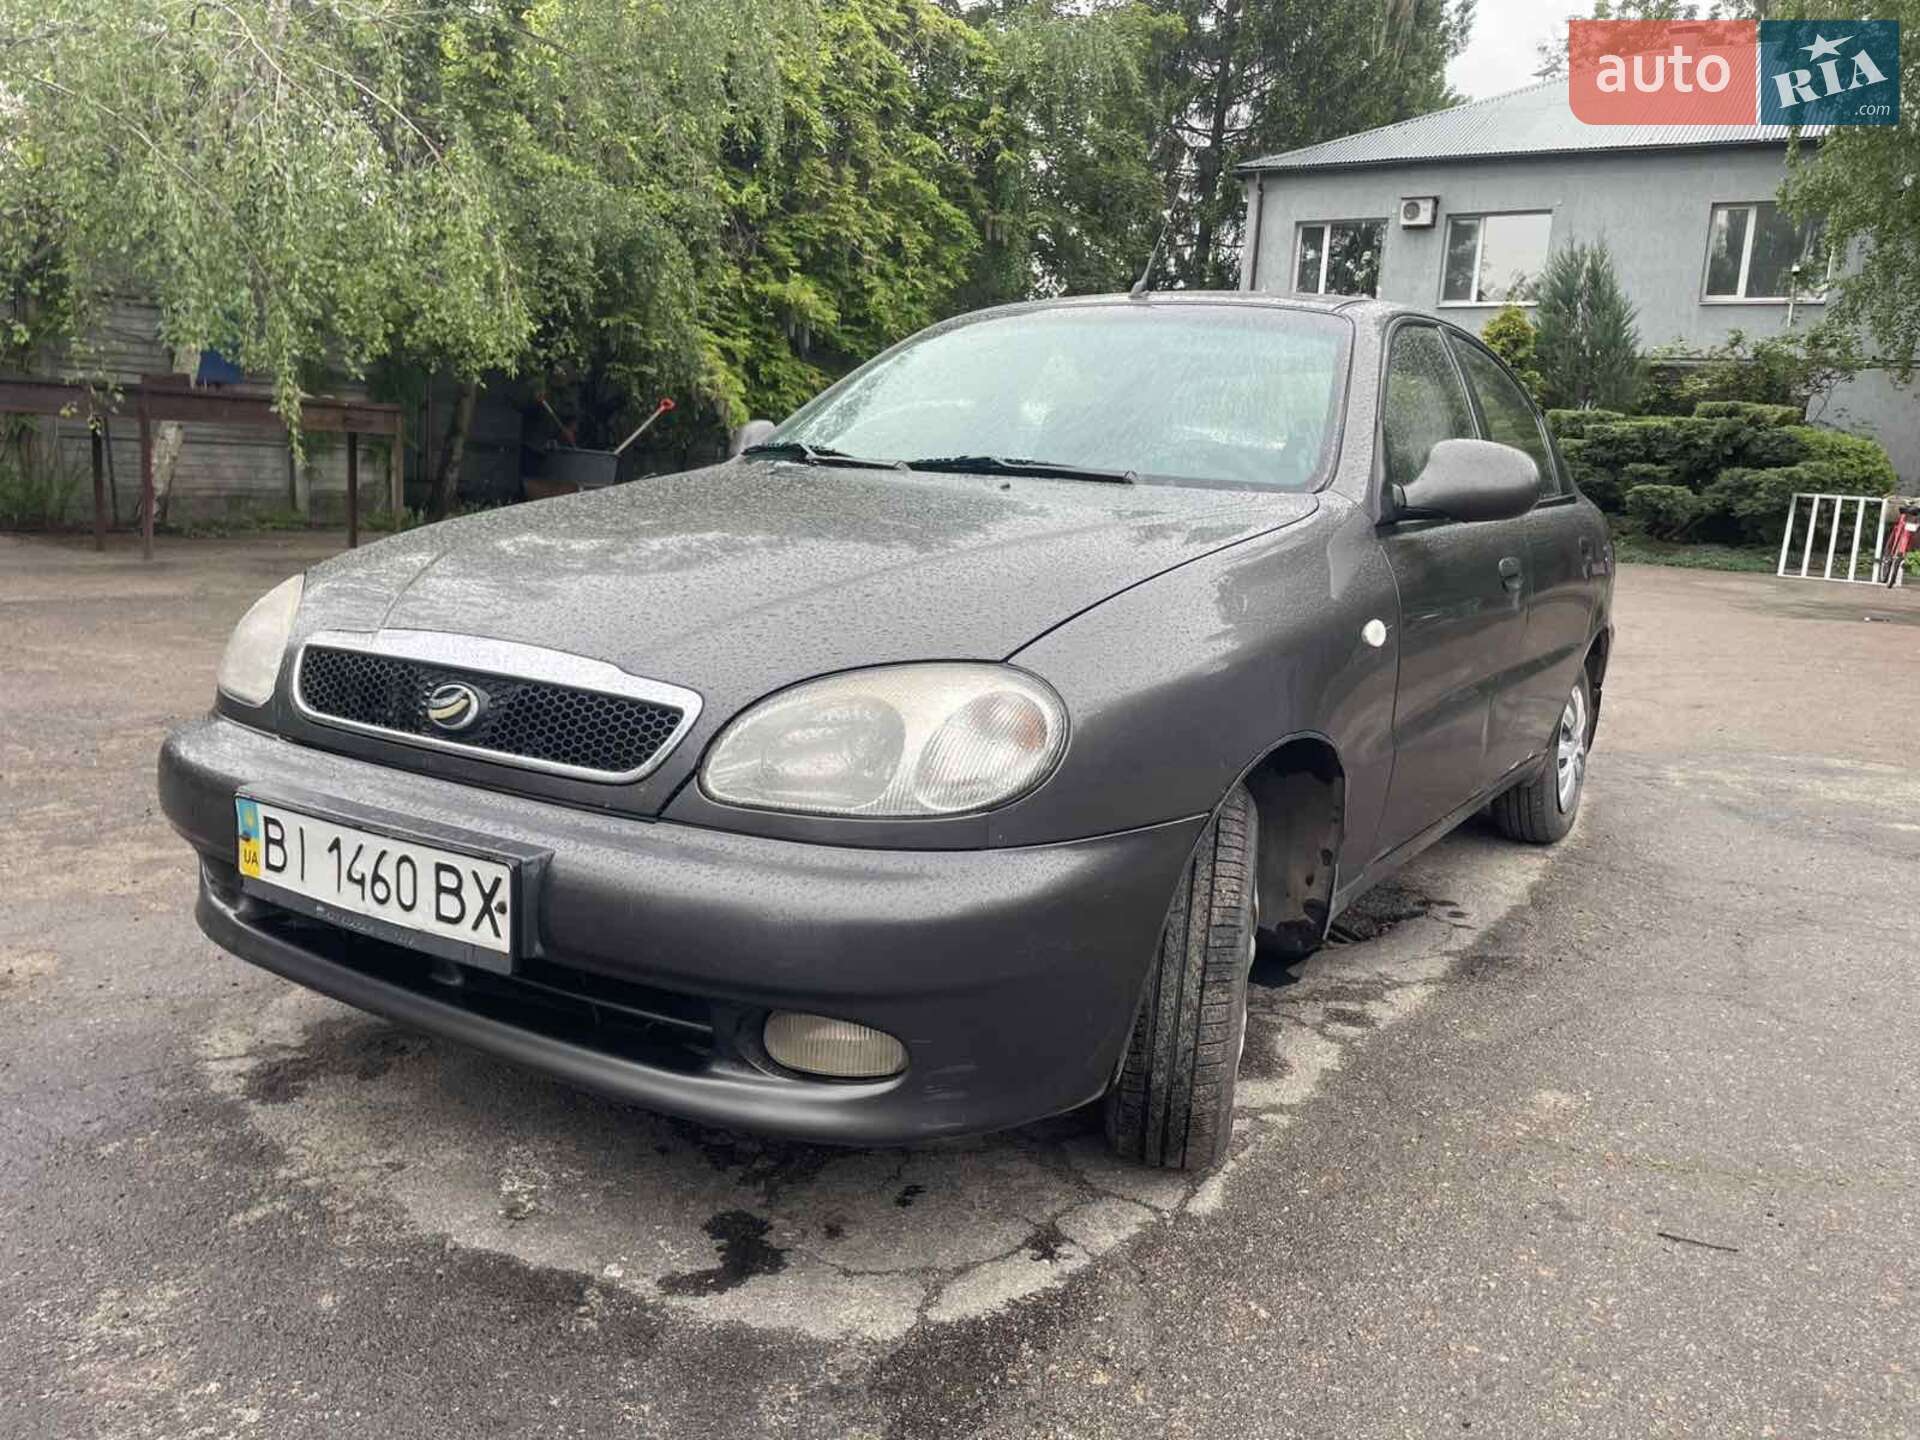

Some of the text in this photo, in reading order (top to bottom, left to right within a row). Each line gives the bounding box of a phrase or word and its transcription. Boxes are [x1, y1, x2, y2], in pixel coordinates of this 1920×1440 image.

[243, 848, 259, 865] UA
[263, 815, 305, 882] BI
[327, 836, 417, 912] 1460
[434, 861, 502, 938] BX
